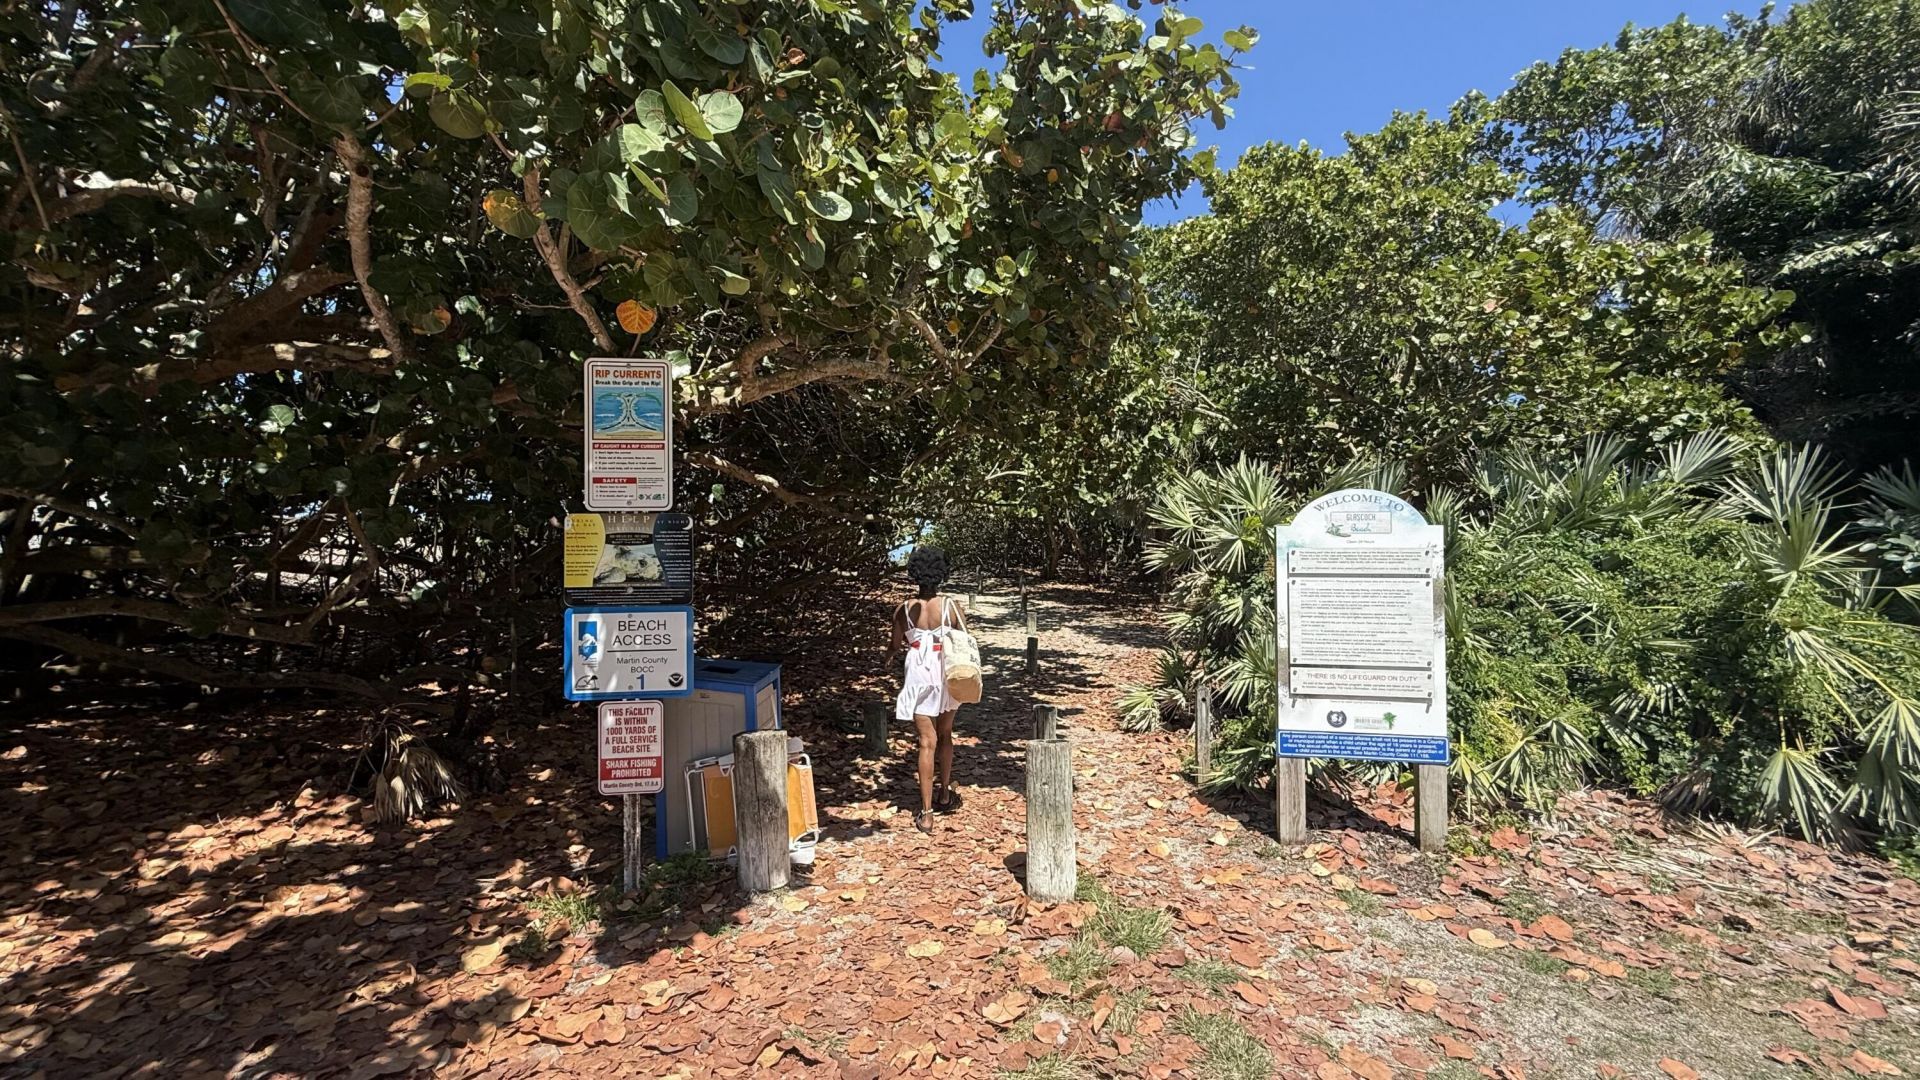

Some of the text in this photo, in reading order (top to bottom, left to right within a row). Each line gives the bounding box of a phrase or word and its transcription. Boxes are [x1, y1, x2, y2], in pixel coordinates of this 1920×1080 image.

[595, 370, 662, 378] RIP CURRENTS
[1314, 494, 1404, 511] WELCOME TO
[1351, 522, 1371, 532] Beach
[618, 620, 667, 631] BEACH
[613, 634, 672, 646] ACCESS
[636, 674, 645, 690] 1
[625, 708, 654, 716] FACILITY
[624, 717, 648, 725] WITHIN
[625, 726, 646, 734] YARDS
[630, 735, 657, 743] SERVICE
[612, 745, 634, 753] BEACH
[606, 759, 657, 769] SHARK FISHING
[611, 768, 652, 778] PROHIBITED
